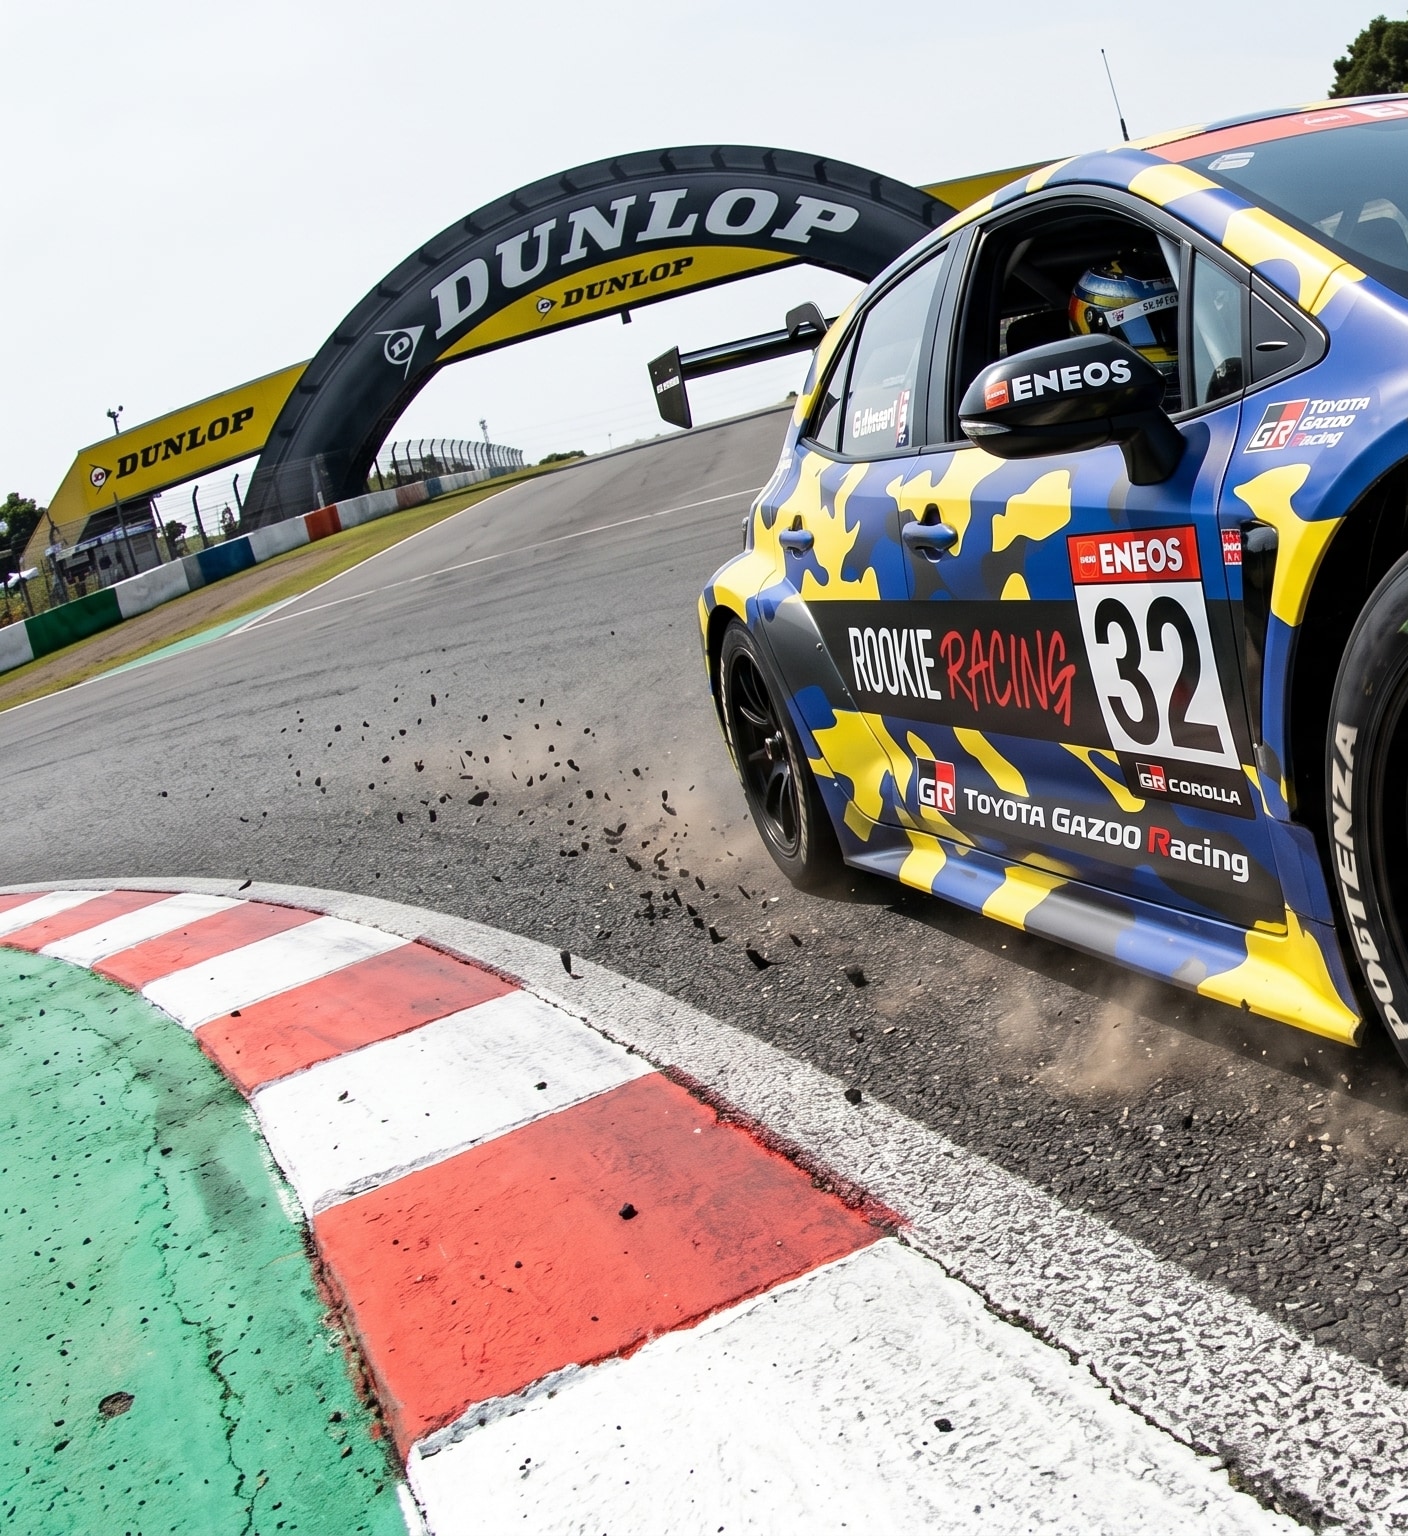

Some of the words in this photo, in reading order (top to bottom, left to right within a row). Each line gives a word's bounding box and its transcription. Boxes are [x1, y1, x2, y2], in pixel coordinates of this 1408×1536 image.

[430, 188, 860, 340] DUNLOP
[561, 256, 693, 309] DUNLOP
[1011, 359, 1132, 401] ENEOS
[1298, 415, 1356, 431] GAZOO
[1309, 397, 1370, 414] TOYOTA
[116, 406, 254, 480] DUNLOP
[1249, 420, 1297, 449] GR
[1290, 432, 1344, 448] Racing
[1098, 537, 1183, 574] ENEOS
[847, 627, 942, 700] ROOKIE
[939, 629, 1076, 727] RACING
[1093, 596, 1226, 755] 32
[1140, 771, 1167, 791] GR
[1168, 778, 1242, 806] COROLLA
[918, 777, 954, 812] GR
[963, 788, 1046, 829] TOYOTA
[1051, 807, 1142, 850] GAZOO
[1148, 825, 1250, 883] Racing
